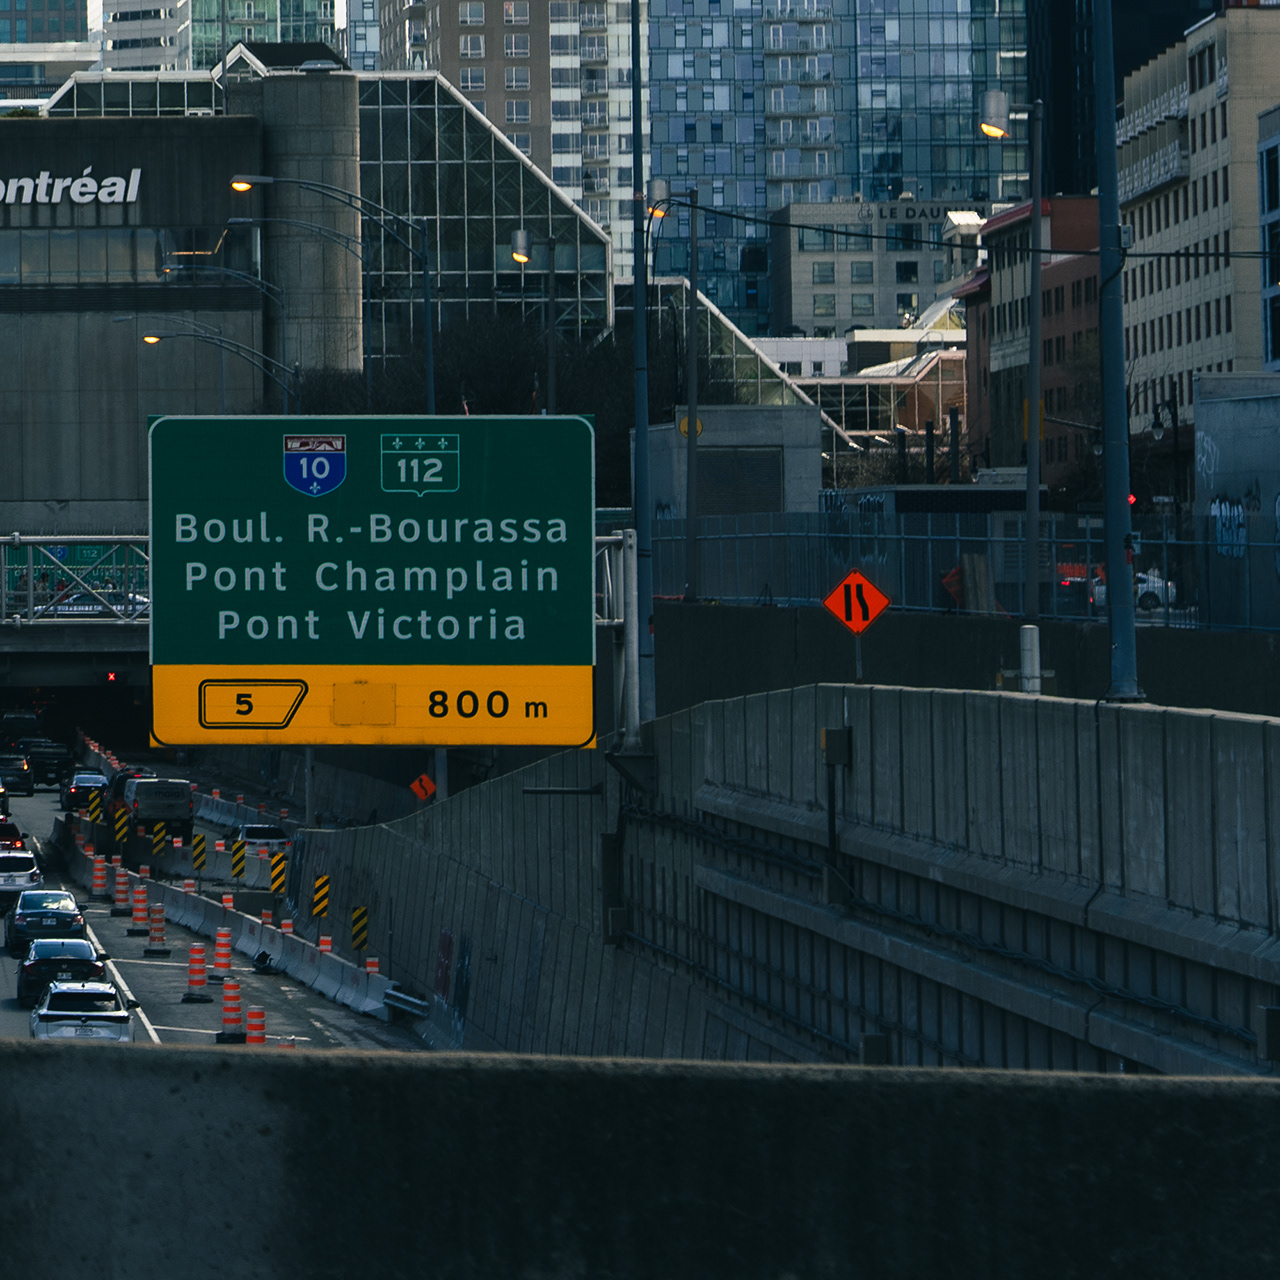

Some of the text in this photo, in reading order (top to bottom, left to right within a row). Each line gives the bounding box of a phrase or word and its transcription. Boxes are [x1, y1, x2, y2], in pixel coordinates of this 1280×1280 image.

[880, 207, 897, 219] LE
[299, 456, 330, 480] 10
[397, 457, 443, 483] 112
[175, 511, 567, 543] Boul. R.-Bourassa
[186, 559, 558, 600] Pont Champlain
[218, 607, 526, 640] Pont Victoria
[235, 693, 255, 717] 5
[428, 690, 549, 719] 800 m
